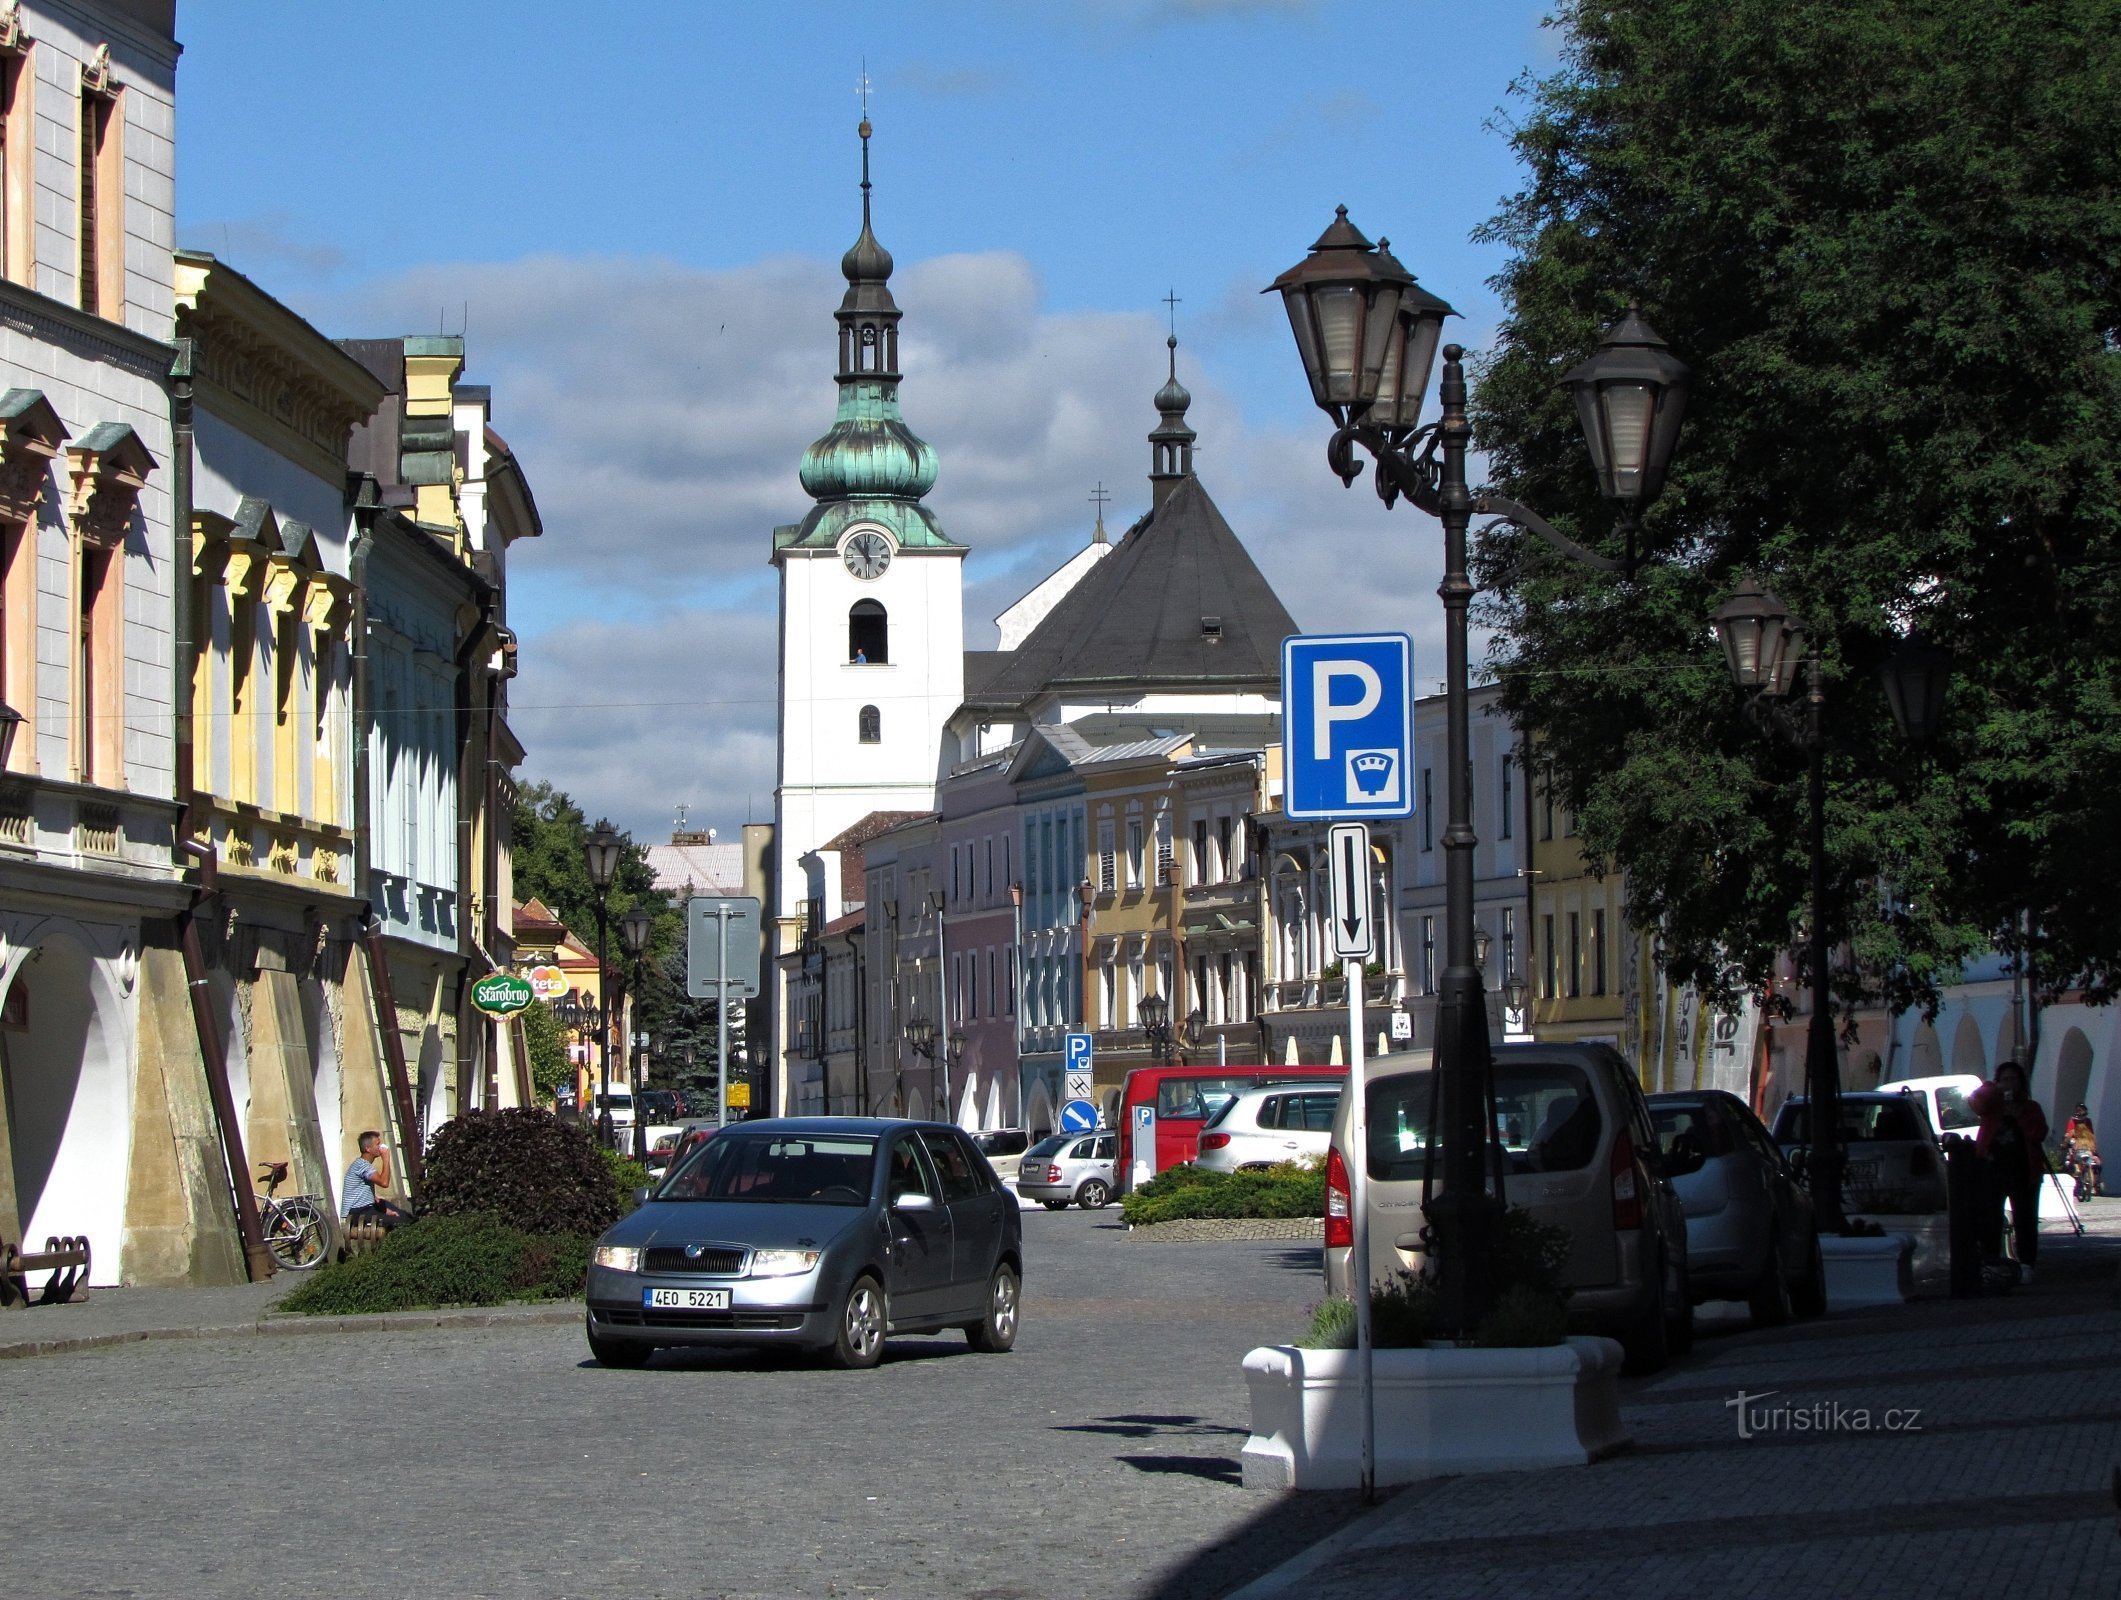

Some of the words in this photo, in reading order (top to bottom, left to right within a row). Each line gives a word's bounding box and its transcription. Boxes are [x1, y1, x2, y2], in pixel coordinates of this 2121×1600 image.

[1312, 659, 1383, 761] P
[532, 979, 563, 990] teta
[478, 981, 529, 1009] Starobrno
[1071, 1038, 1087, 1060] P
[1141, 1109, 1151, 1123] P
[689, 1292, 722, 1307] 5221
